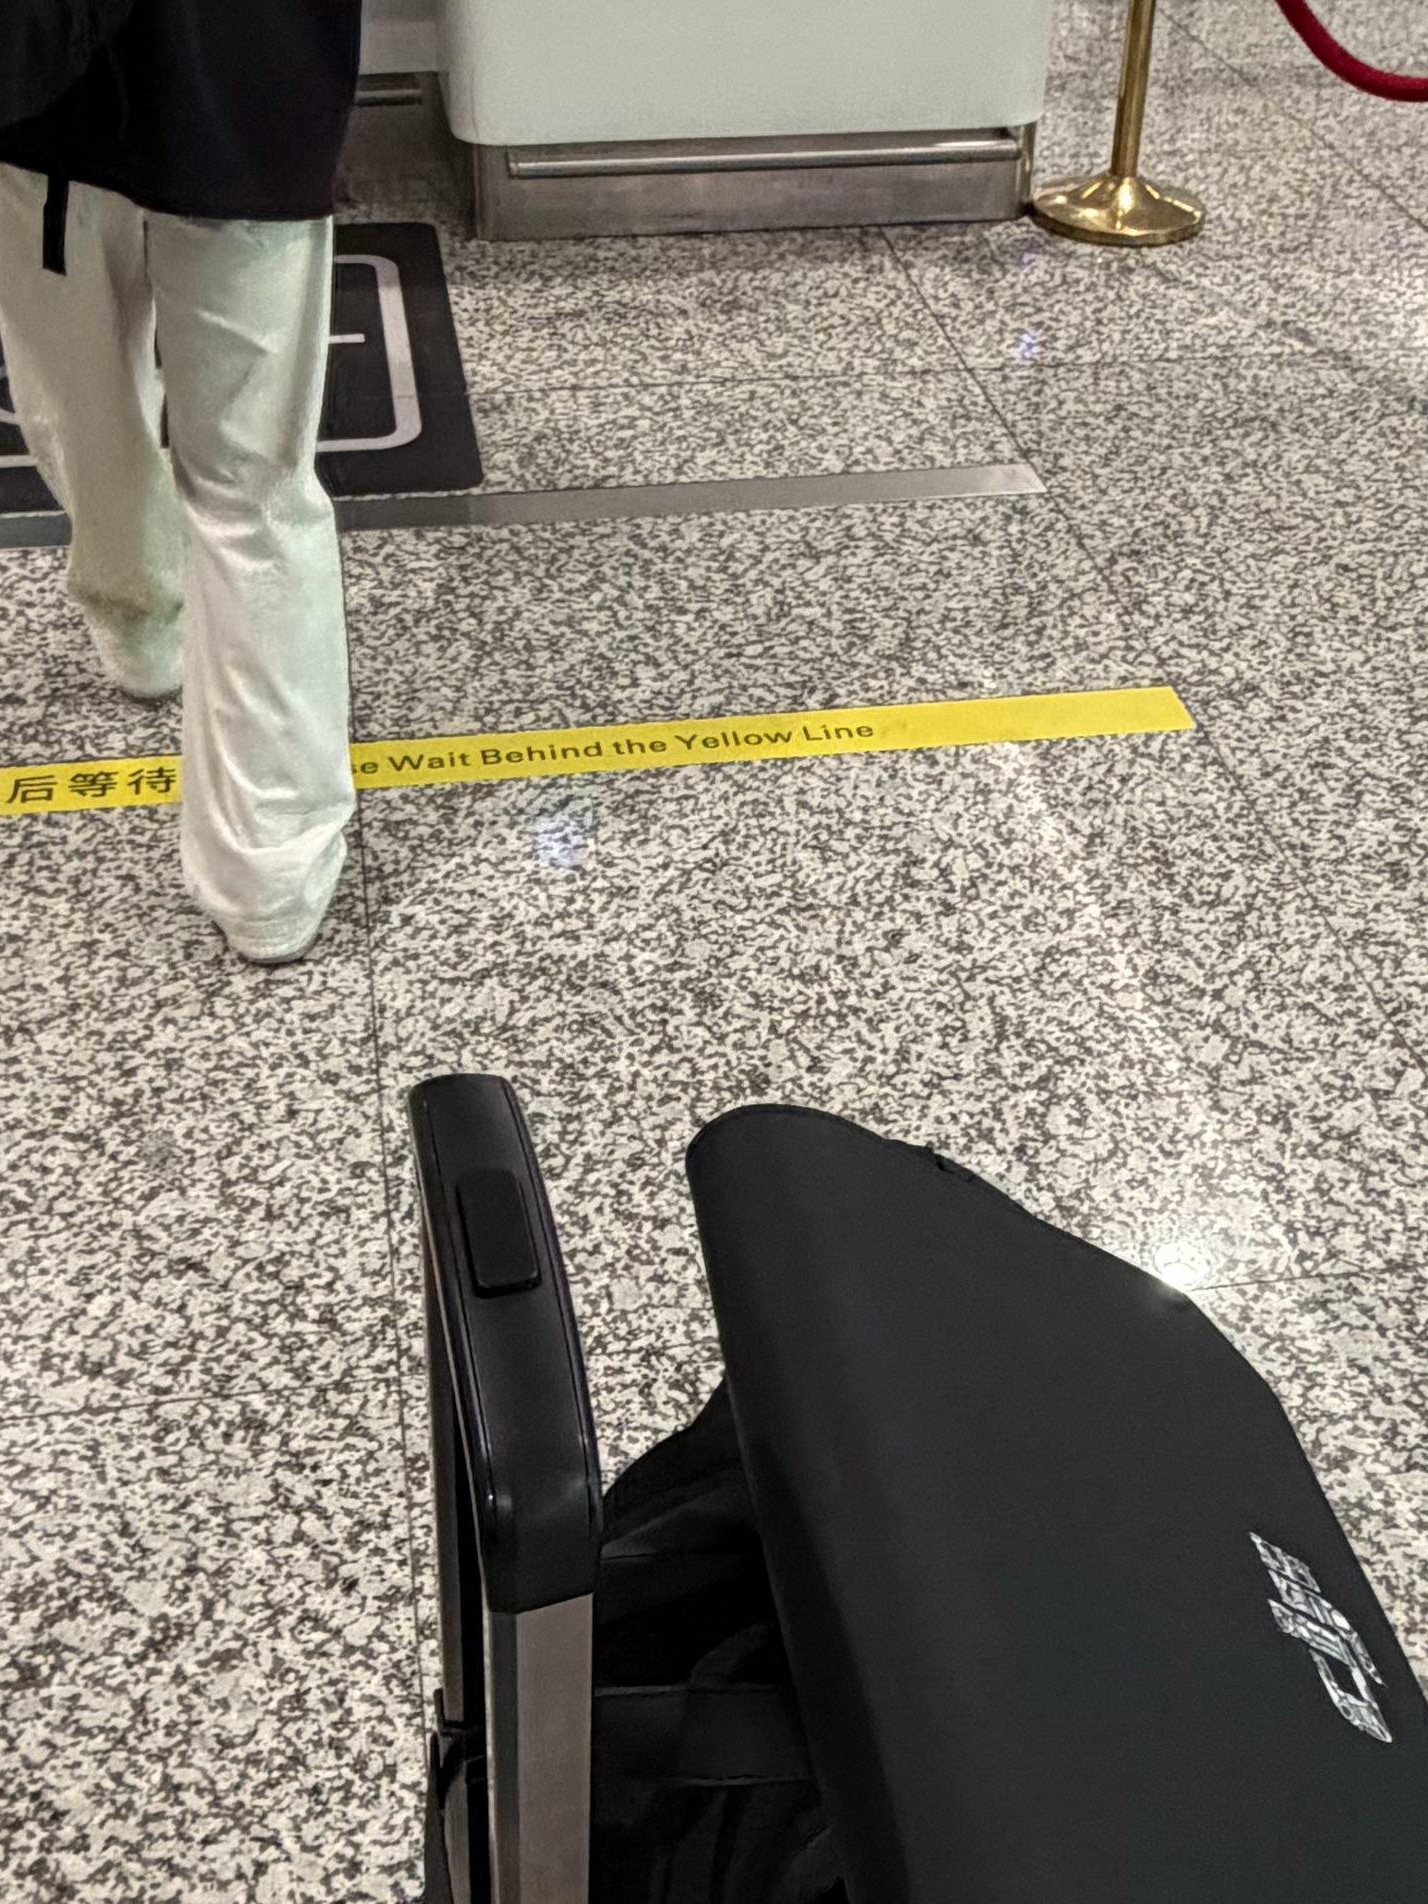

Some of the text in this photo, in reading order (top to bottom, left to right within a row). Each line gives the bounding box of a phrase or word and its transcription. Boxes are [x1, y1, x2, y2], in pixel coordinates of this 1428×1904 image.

[388, 749, 471, 773] Wait
[480, 737, 604, 767] Behind
[612, 734, 668, 758] the
[674, 725, 793, 751] Yellow
[802, 720, 875, 743] Line
